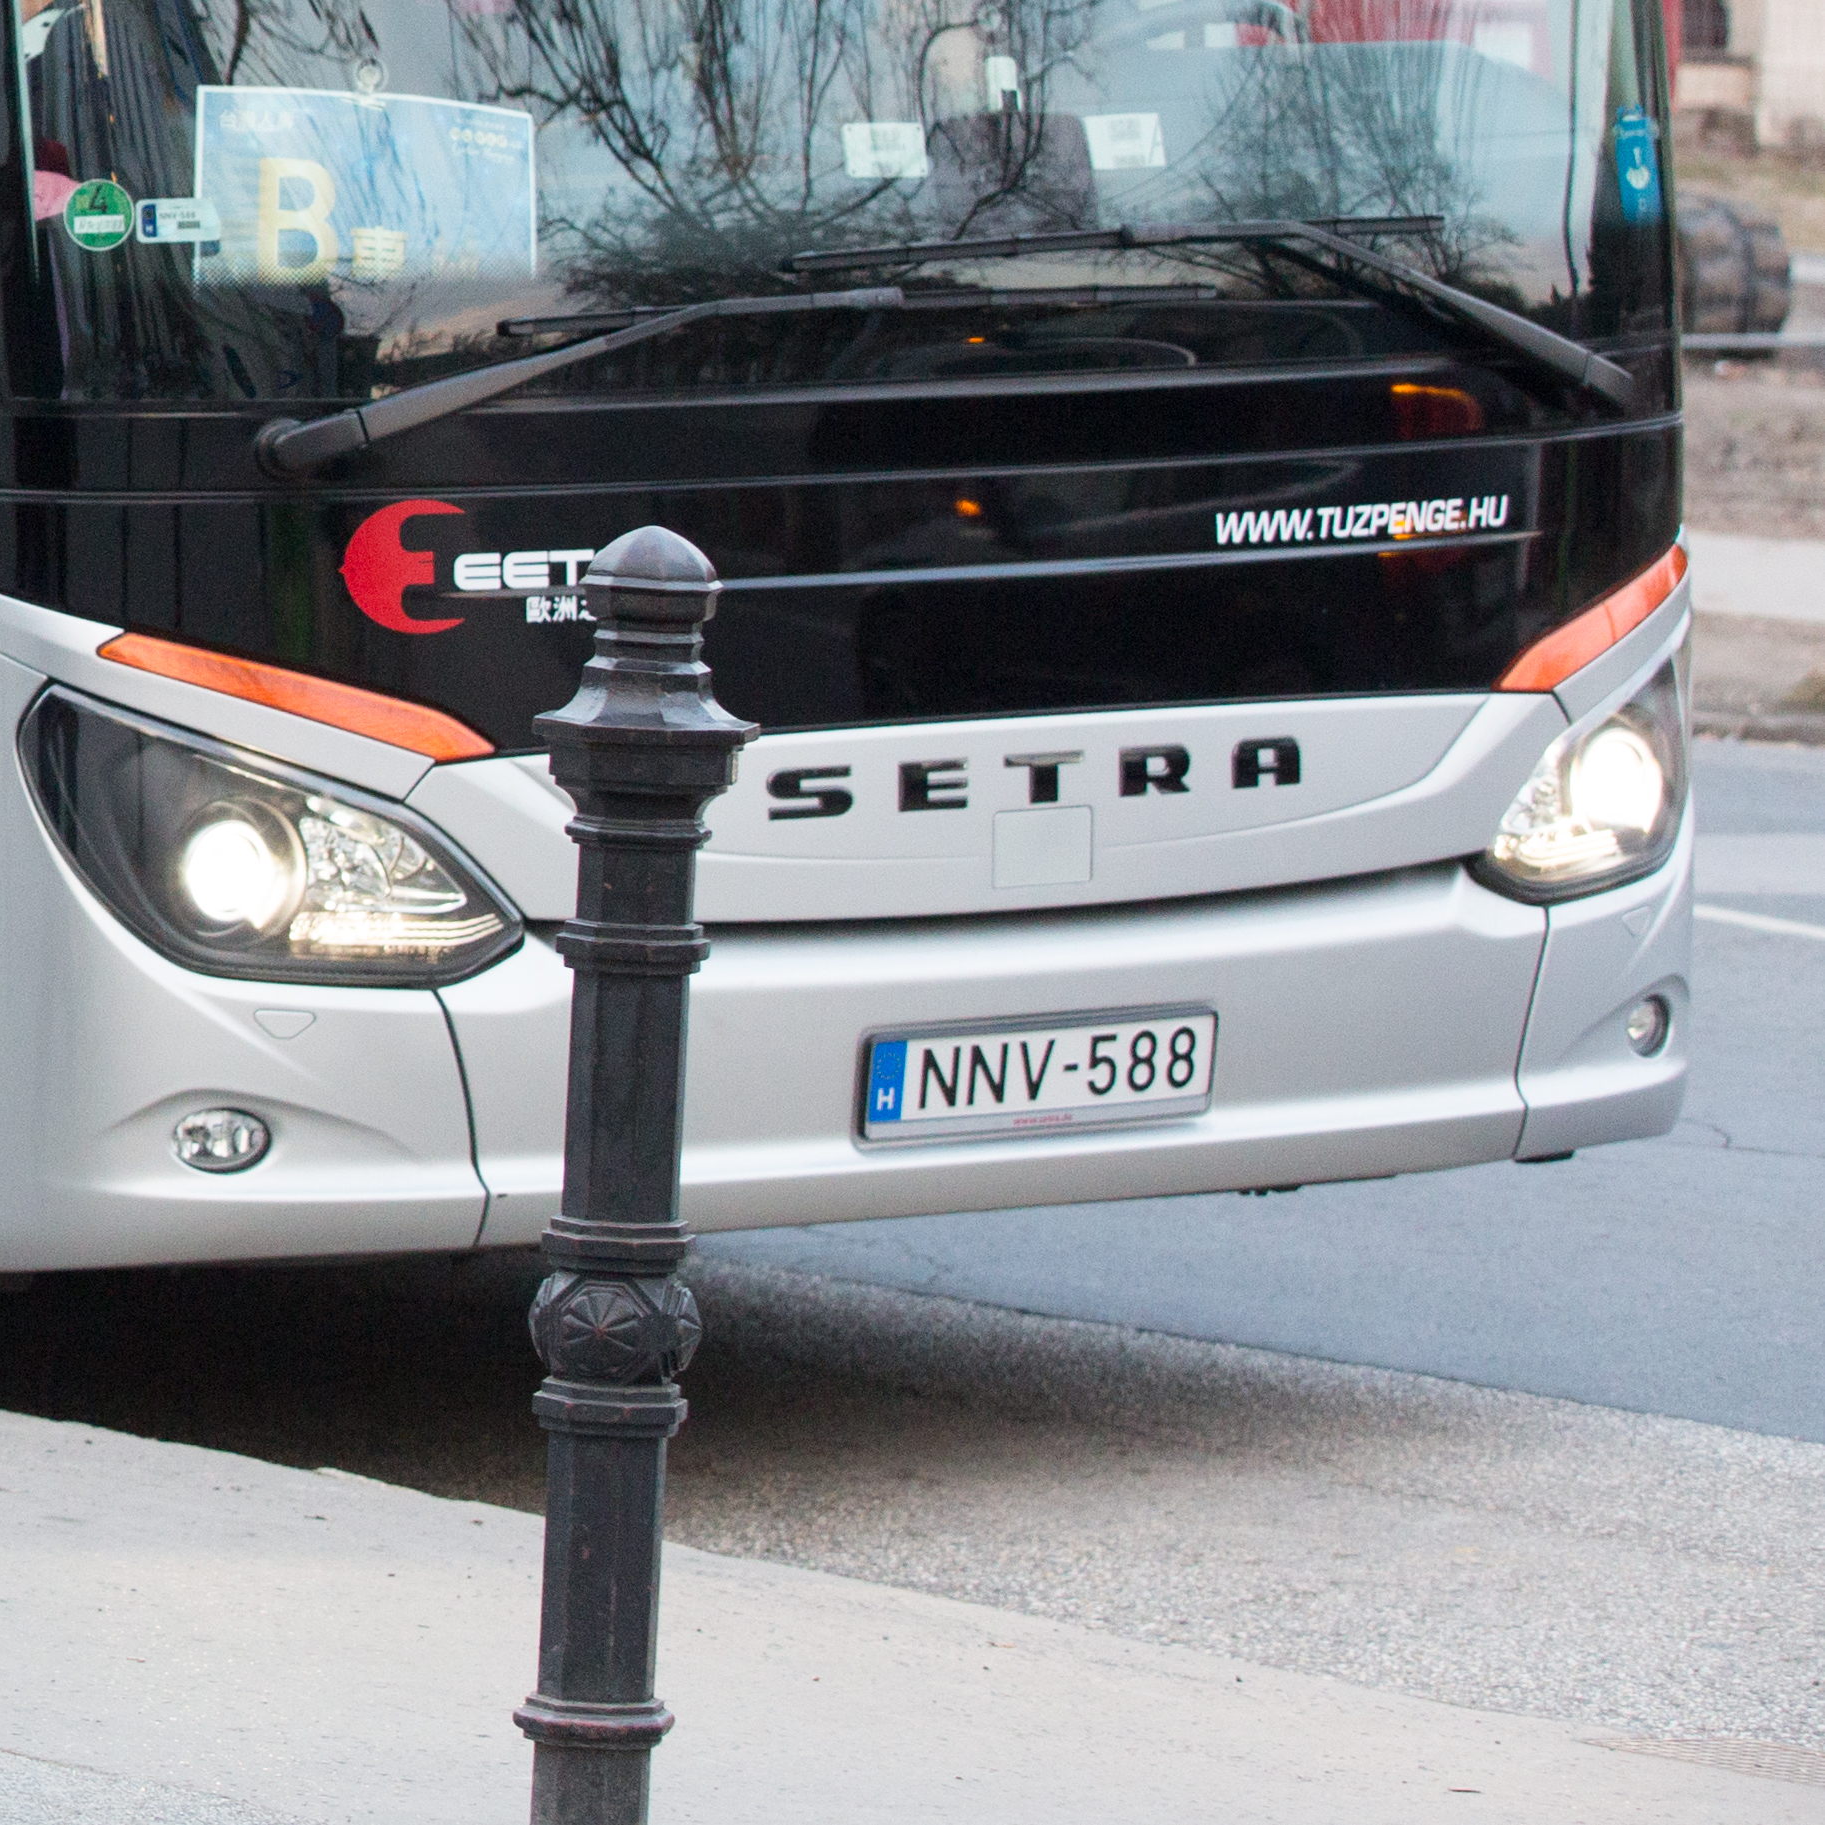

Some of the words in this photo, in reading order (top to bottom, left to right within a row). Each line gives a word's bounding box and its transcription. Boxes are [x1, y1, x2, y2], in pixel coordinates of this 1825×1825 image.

[259, 158, 337, 275] B
[1215, 494, 1508, 545] WWW.TUZPENGE.HU
[454, 549, 595, 591] EET
[766, 736, 1302, 821] SETRA
[877, 1087, 895, 1111] H
[918, 1026, 1197, 1110] NNV-588
